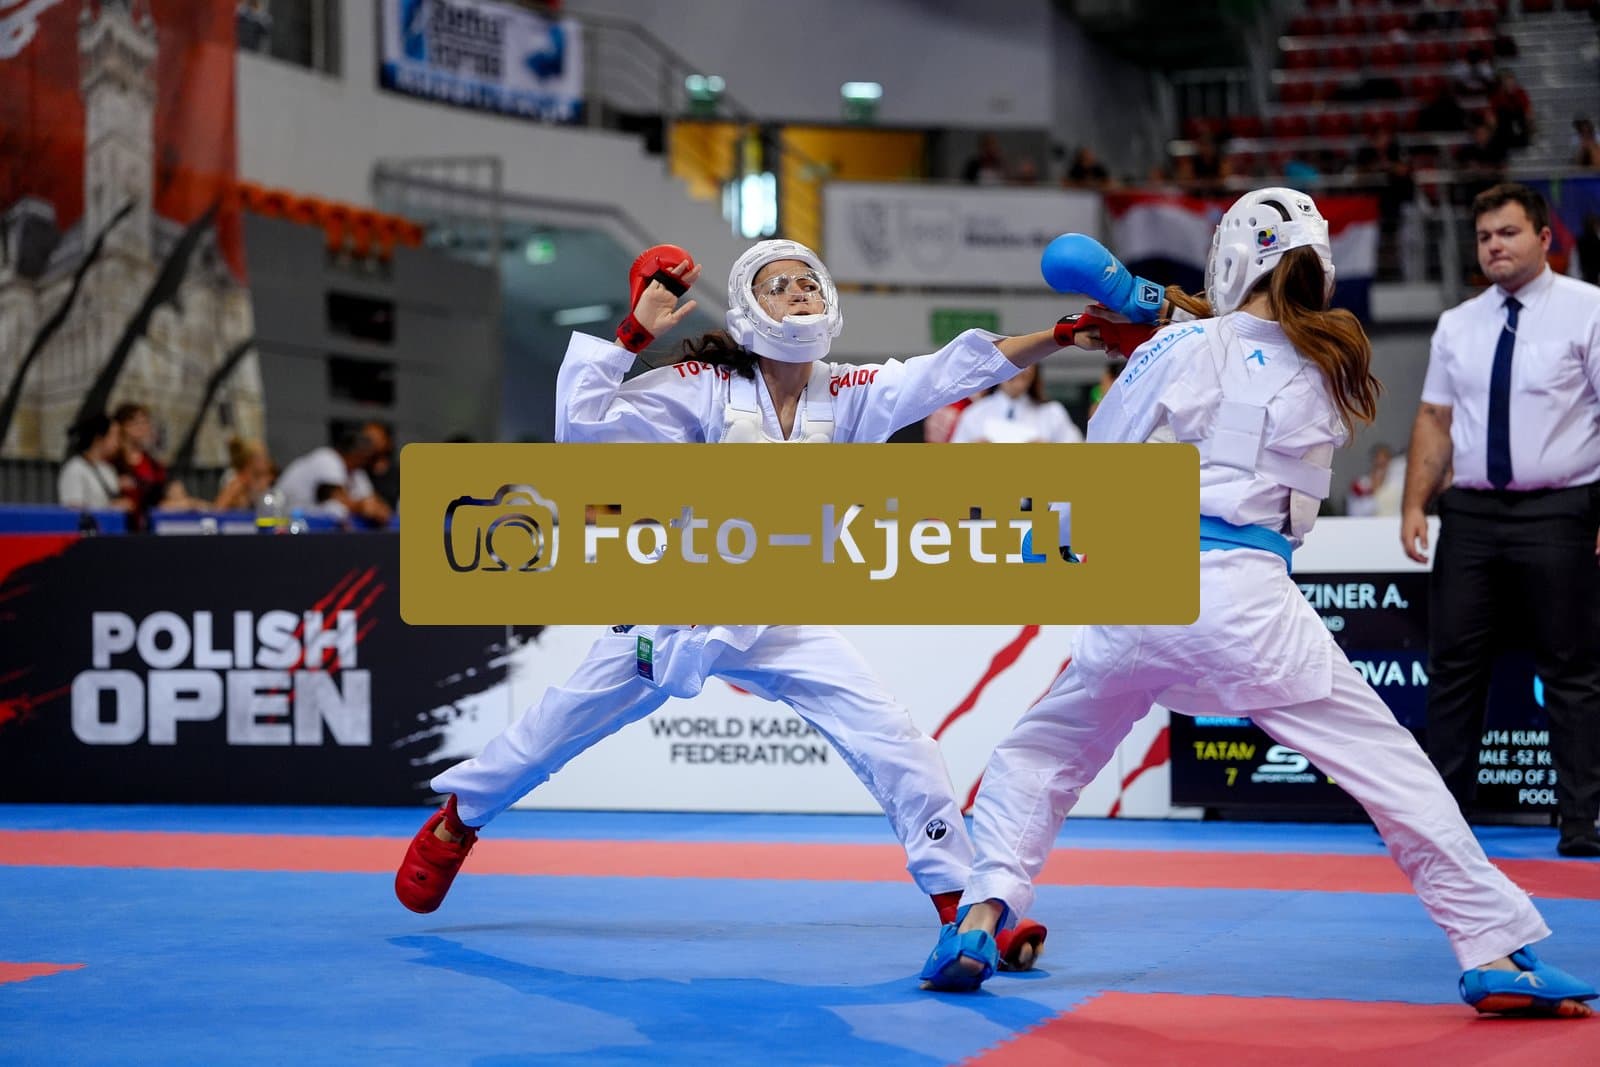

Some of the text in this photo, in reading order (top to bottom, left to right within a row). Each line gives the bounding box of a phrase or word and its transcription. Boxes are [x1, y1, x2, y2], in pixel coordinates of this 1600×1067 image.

[1298, 583, 1378, 609] ZINER
[92, 610, 358, 669] POLISH
[71, 669, 371, 745] OPEN
[650, 717, 821, 738] WORLD KARA
[1511, 730, 1550, 746] KUMI
[671, 744, 828, 764] FEDERATION
[1194, 741, 1256, 760] TATAM
[1225, 767, 1238, 786] 7
[1477, 768, 1523, 785] OUND
[1525, 768, 1546, 785] OF
[1518, 788, 1559, 805] POOL
